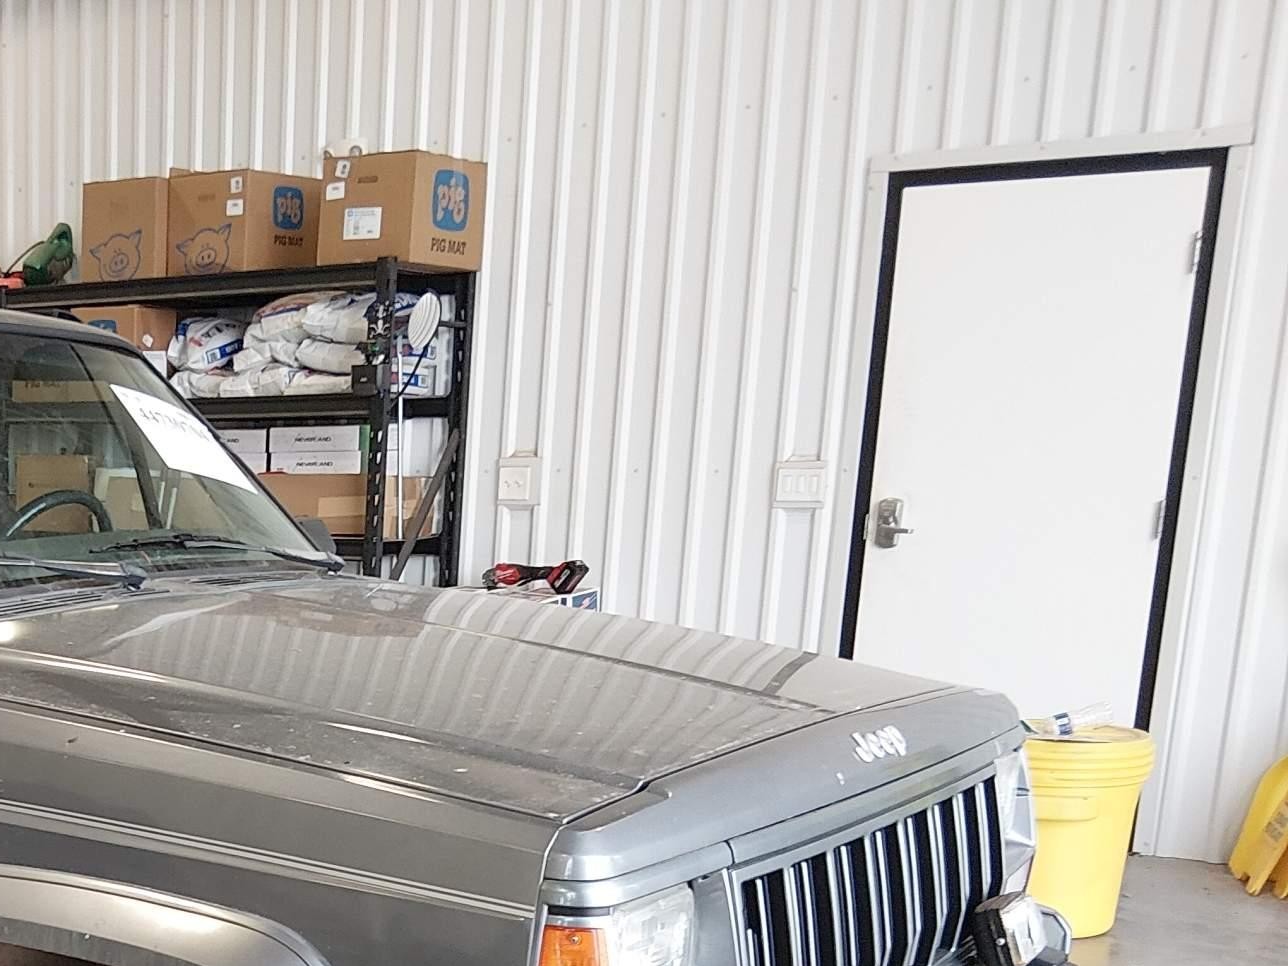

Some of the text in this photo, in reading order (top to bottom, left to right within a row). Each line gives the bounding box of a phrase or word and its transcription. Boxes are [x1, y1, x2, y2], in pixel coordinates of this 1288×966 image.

[275, 191, 302, 225] pig
[436, 174, 465, 225] pig
[273, 234, 304, 247] PIG MAT
[430, 237, 467, 255] PIG MAT
[851, 724, 907, 763] Jeep
